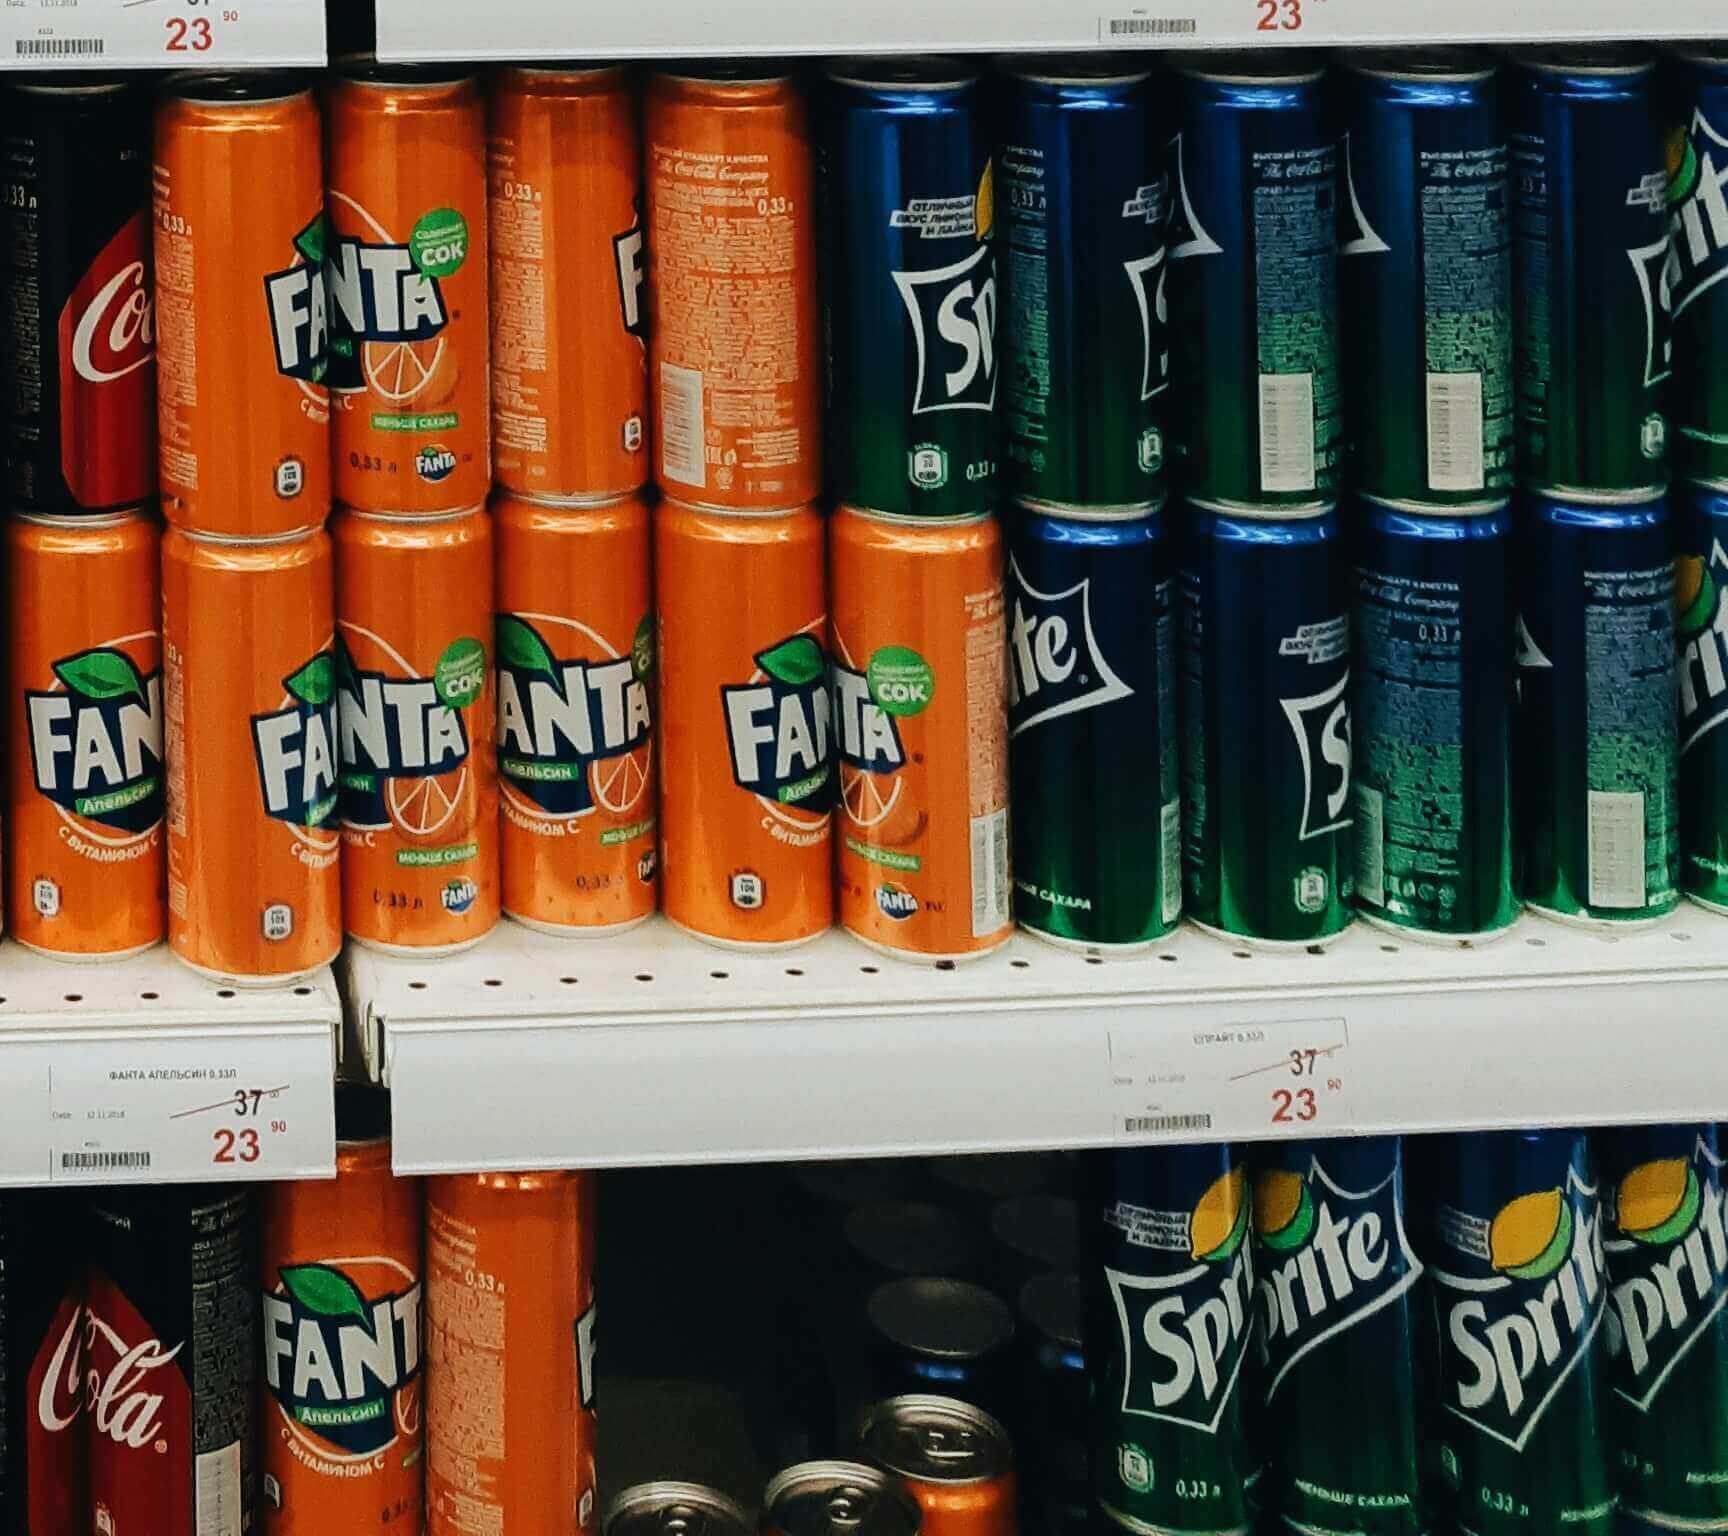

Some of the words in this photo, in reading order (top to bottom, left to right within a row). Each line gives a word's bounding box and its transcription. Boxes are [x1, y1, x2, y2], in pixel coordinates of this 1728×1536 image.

[166, 17, 212, 52] 23
[223, 10, 238, 21] 90
[422, 241, 464, 263] СОК
[878, 681, 927, 704] СОК
[1289, 1049, 1317, 1076] 37
[234, 1090, 262, 1116] 37
[1272, 1088, 1317, 1122] 23
[1327, 1079, 1342, 1090] 90
[213, 1129, 260, 1163] 23
[271, 1121, 287, 1132] 90
[264, 1284, 421, 1401] FANT
[1177, 1478, 1208, 1499] 0,33
